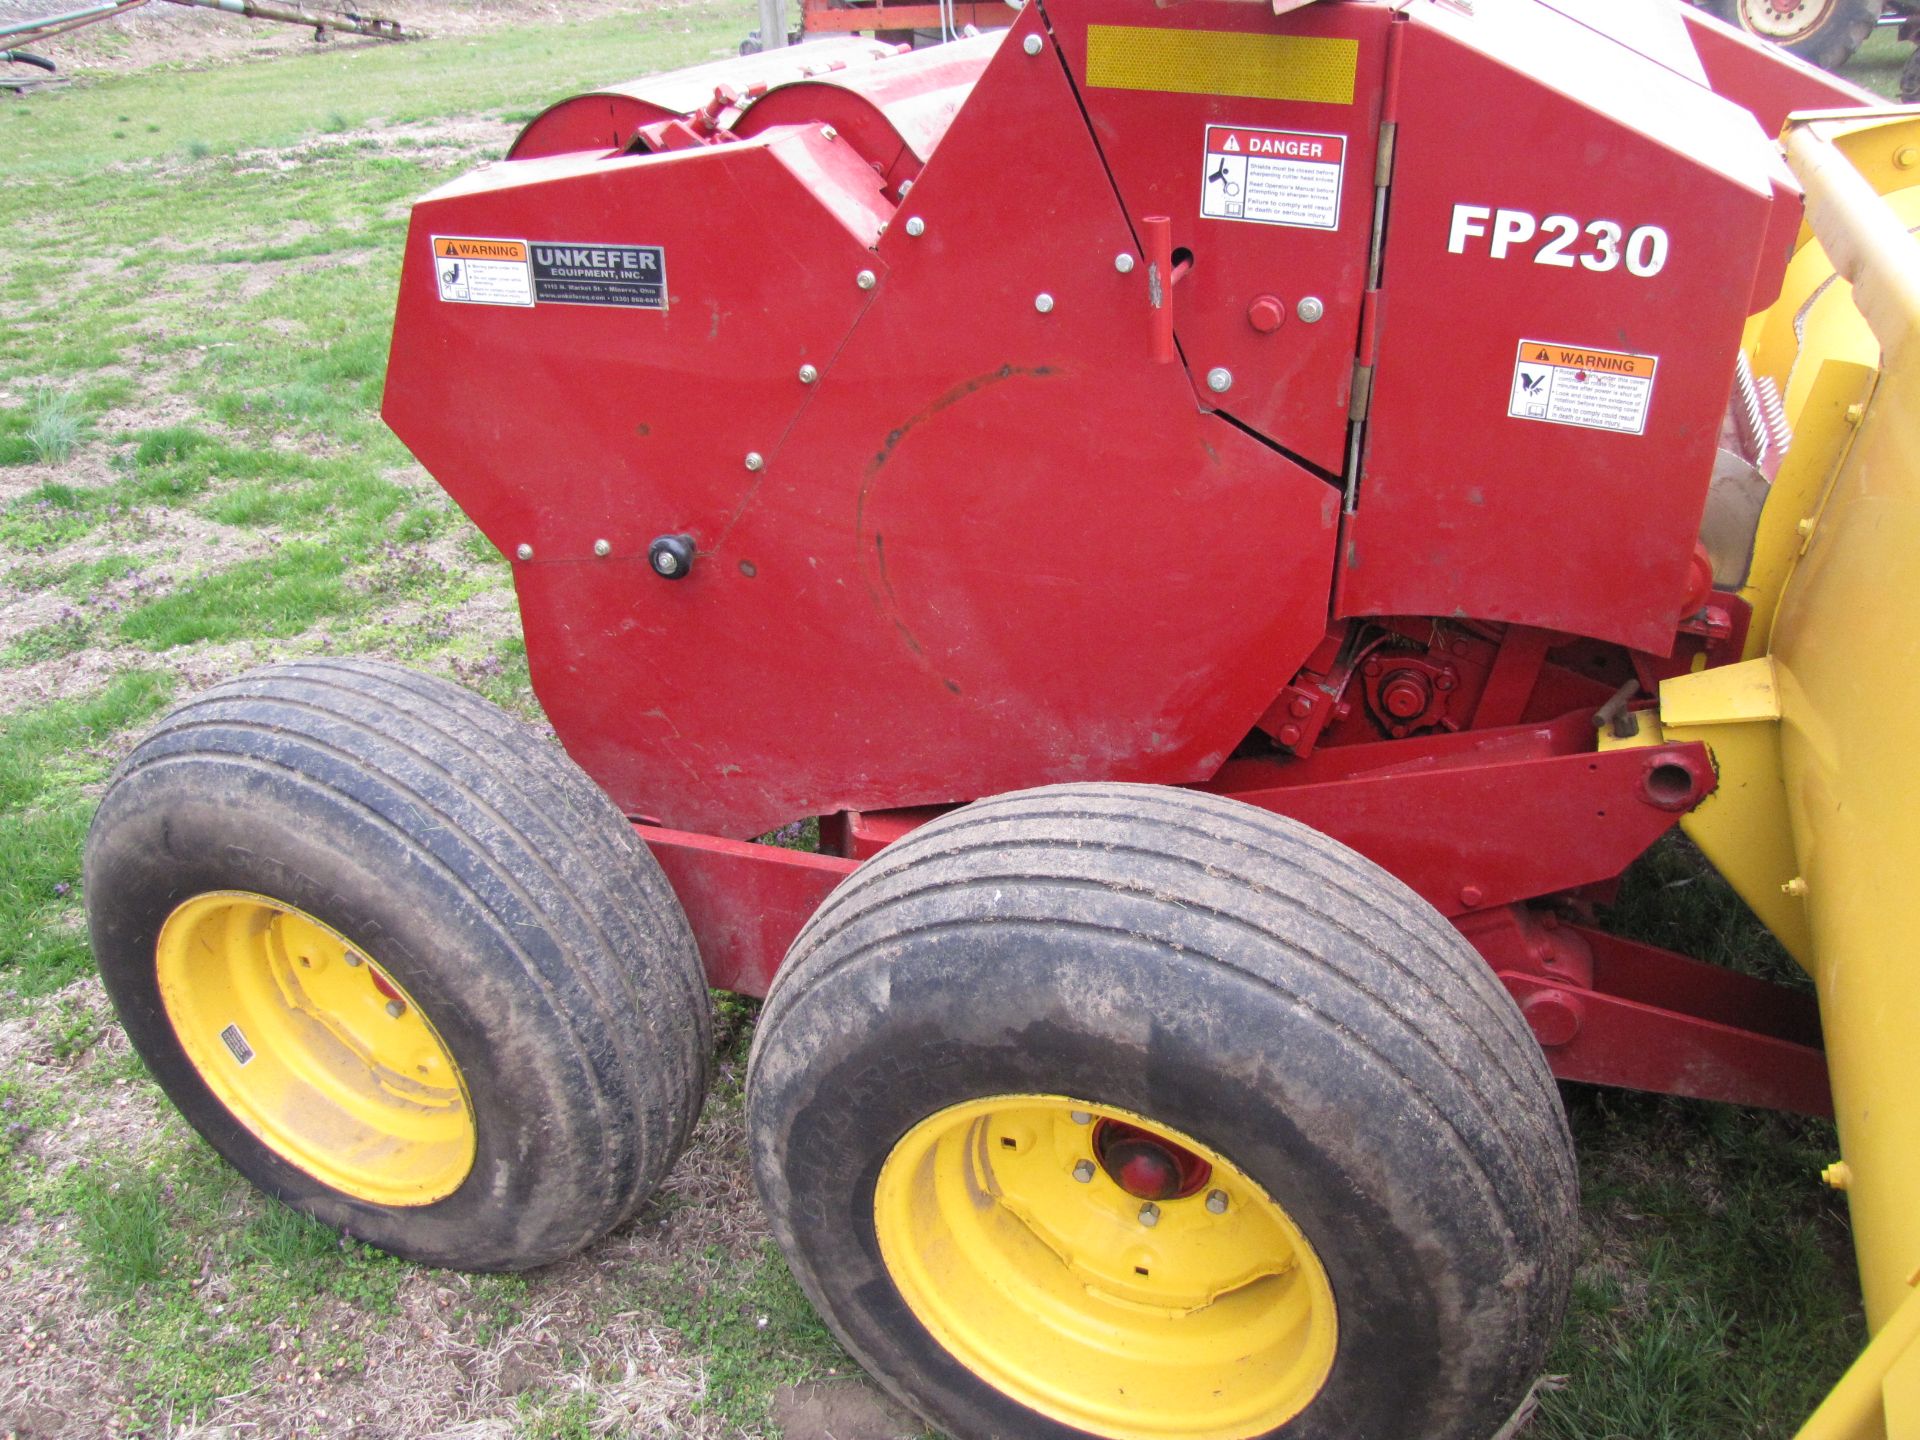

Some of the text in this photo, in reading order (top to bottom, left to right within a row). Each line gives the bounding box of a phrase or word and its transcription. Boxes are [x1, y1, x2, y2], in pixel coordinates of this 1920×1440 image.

[1249, 138, 1322, 158] DANGER
[460, 244, 518, 256] WARNING
[1448, 203, 1669, 277] FP230
[536, 248, 656, 269] UNKEFER
[551, 268, 644, 279] EQUIPMENT, INC.
[1561, 352, 1634, 372] WARNING
[1553, 405, 1571, 413] Failure
[1580, 409, 1600, 418] comply
